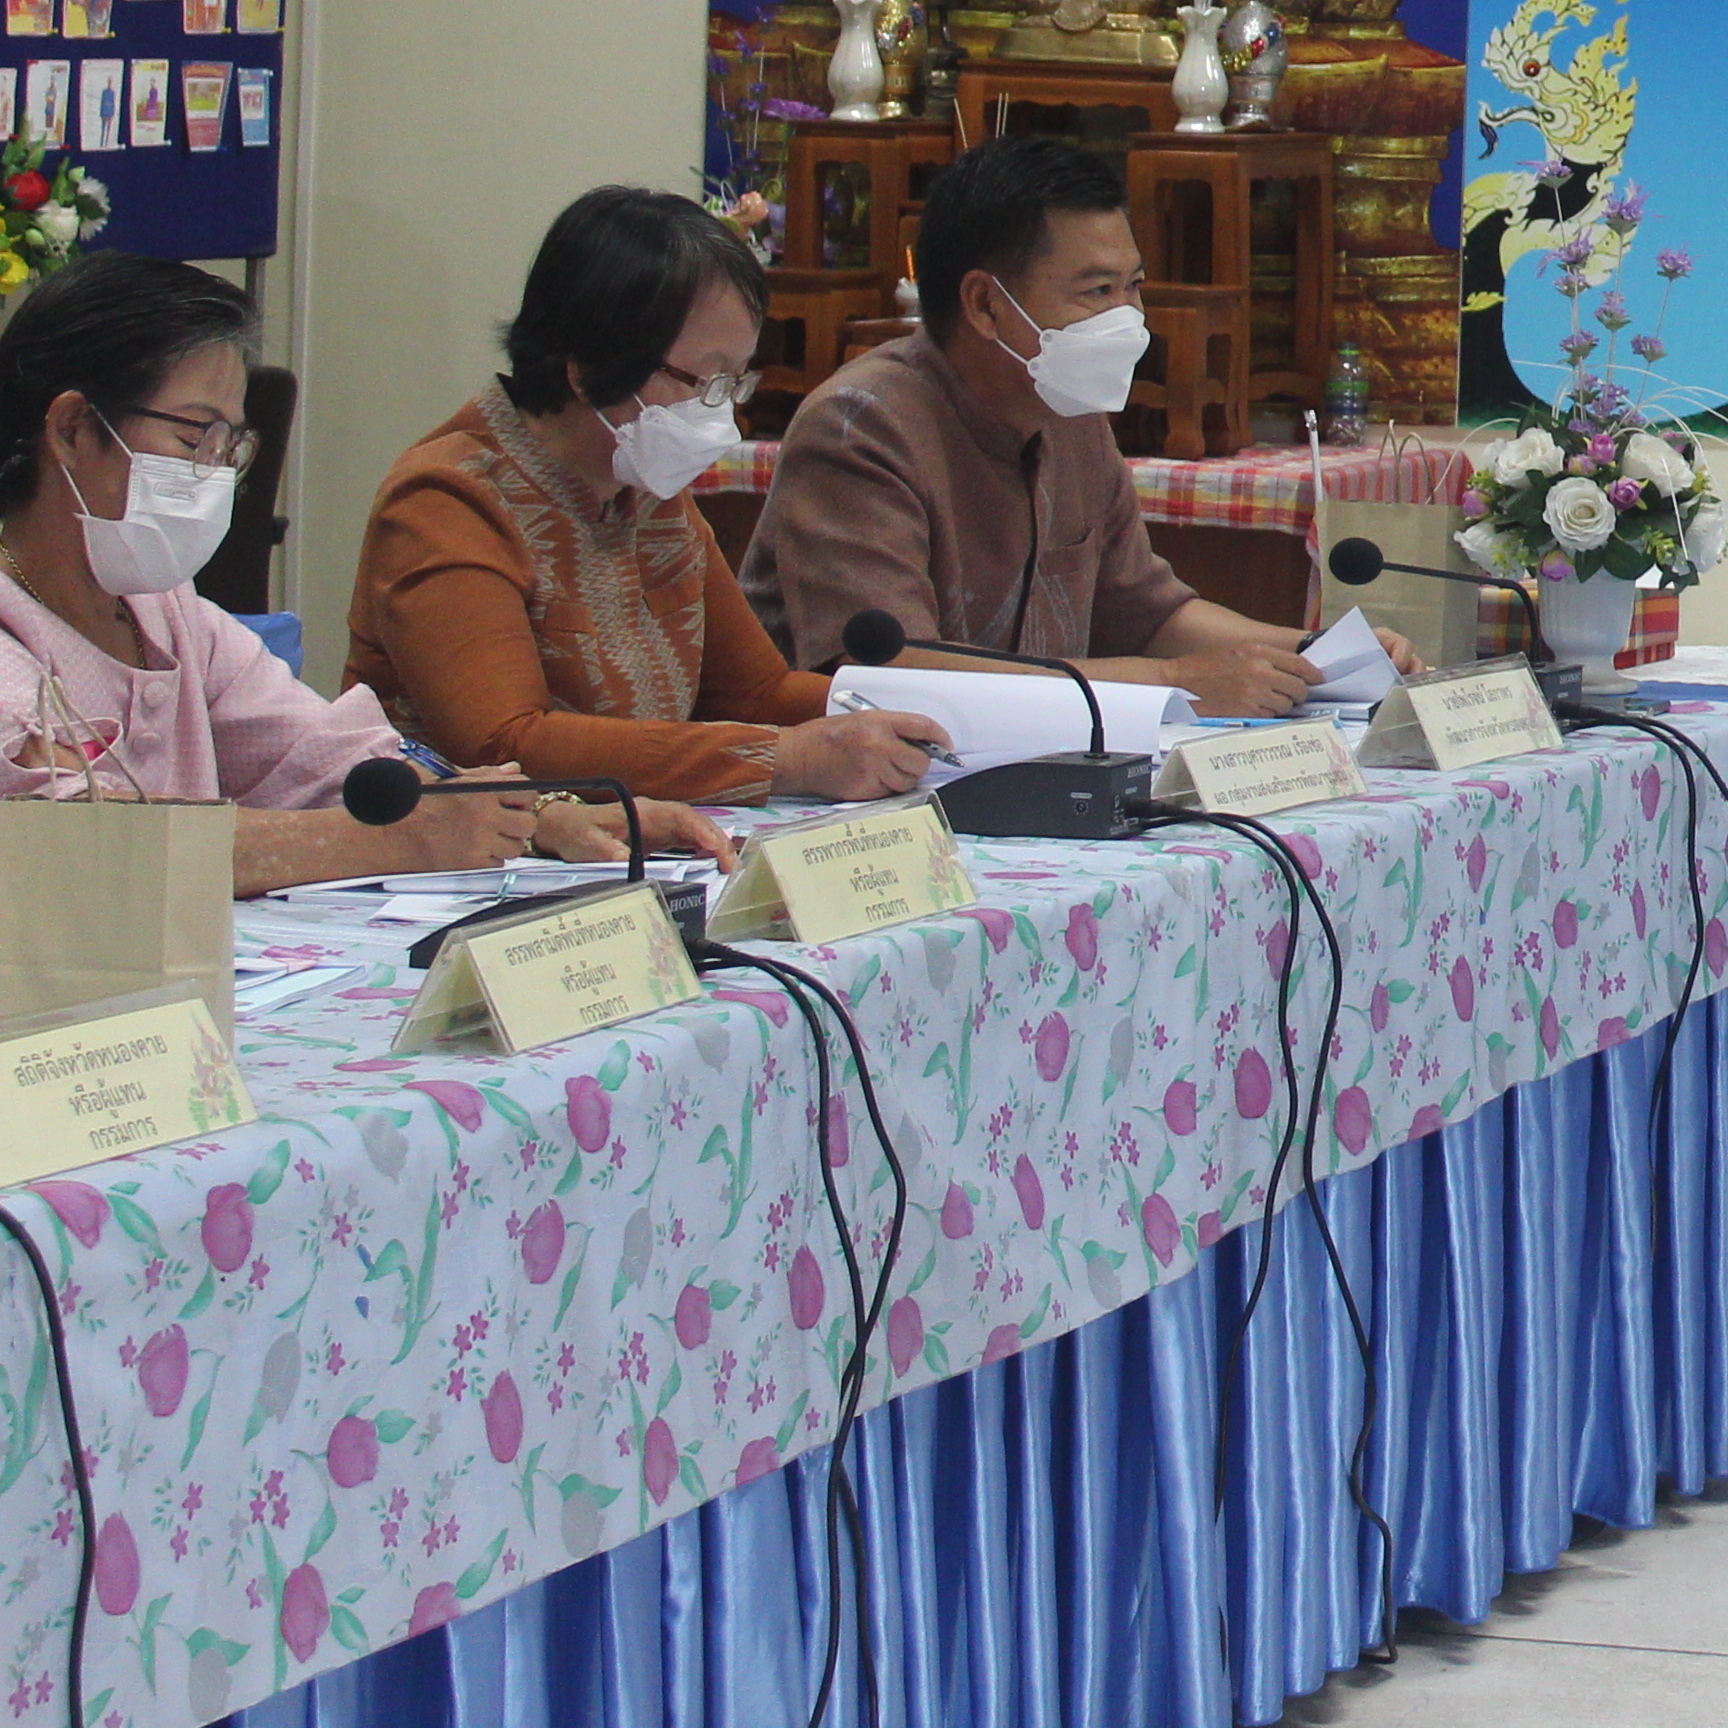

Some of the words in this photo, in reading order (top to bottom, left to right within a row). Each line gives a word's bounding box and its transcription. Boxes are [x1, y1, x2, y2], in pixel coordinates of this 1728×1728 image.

[864, 897, 911, 923] กรรมการ
[504, 913, 637, 966] สรรพสามิตพื้นที่หนองคาย
[560, 960, 618, 995] หรือผู้แทน
[579, 994, 631, 1025] กรรมการ
[13, 1034, 169, 1088] สถิติจังหวัดหนองคาย
[68, 1078, 148, 1119] หรือผู้แทน
[88, 1115, 159, 1151] กรรมการ
